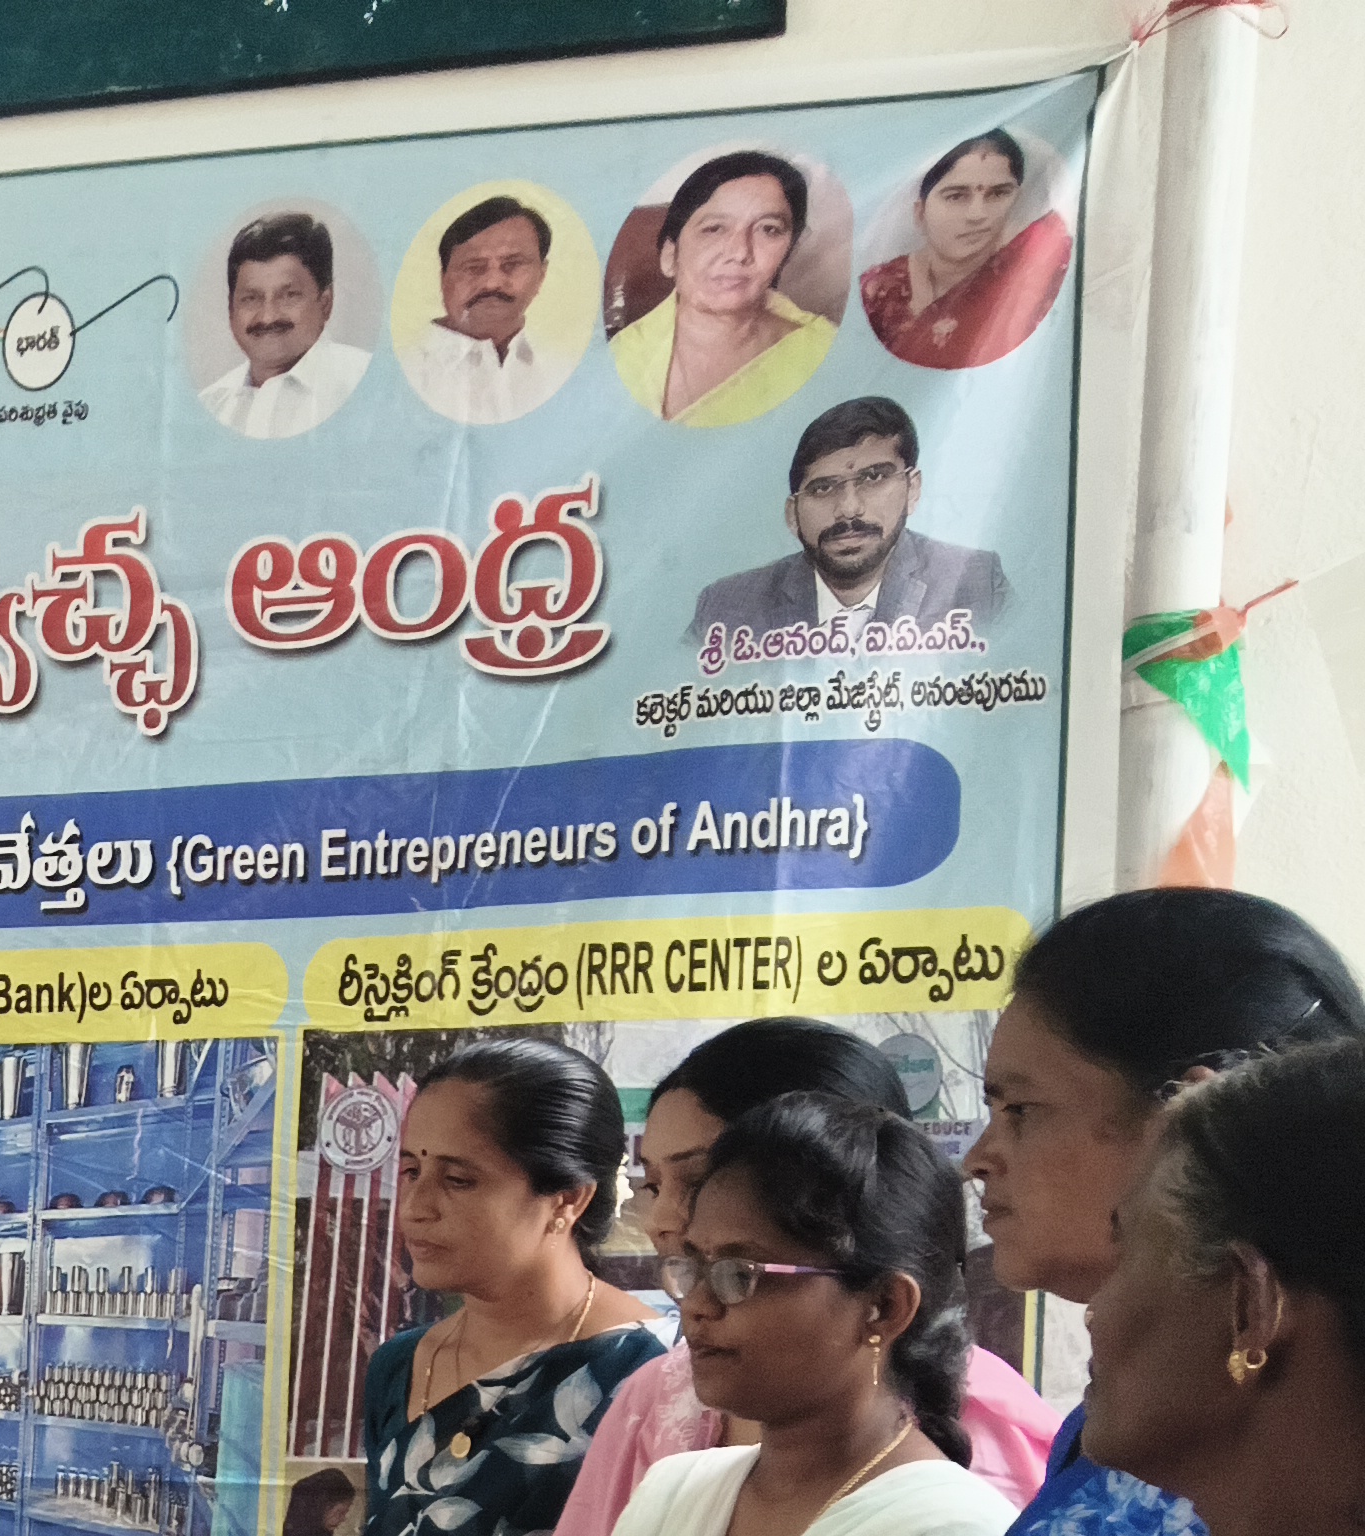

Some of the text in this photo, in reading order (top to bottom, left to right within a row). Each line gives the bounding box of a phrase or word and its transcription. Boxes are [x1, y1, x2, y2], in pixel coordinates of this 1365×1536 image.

[16, 325, 61, 357] భారత్
[227, 473, 609, 677] ఆంధ్ర
[699, 622, 726, 675] శ్రీ
[636, 684, 693, 738] కలెక్టర్
[696, 685, 774, 718] మరియు
[779, 687, 822, 722] జిల్లా
[910, 672, 1048, 714] అనంతపురము
[165, 832, 306, 896] {Green
[320, 818, 616, 885] Entrepreneurs
[630, 802, 678, 857] of
[687, 792, 869, 859] Andhra}
[120, 968, 229, 1026] ఏర్పాటు
[574, 940, 655, 1000] (RRR
[664, 930, 804, 1005] CENTER)
[816, 950, 847, 987] ల
[858, 933, 1005, 1003] ఏర్పాటు
